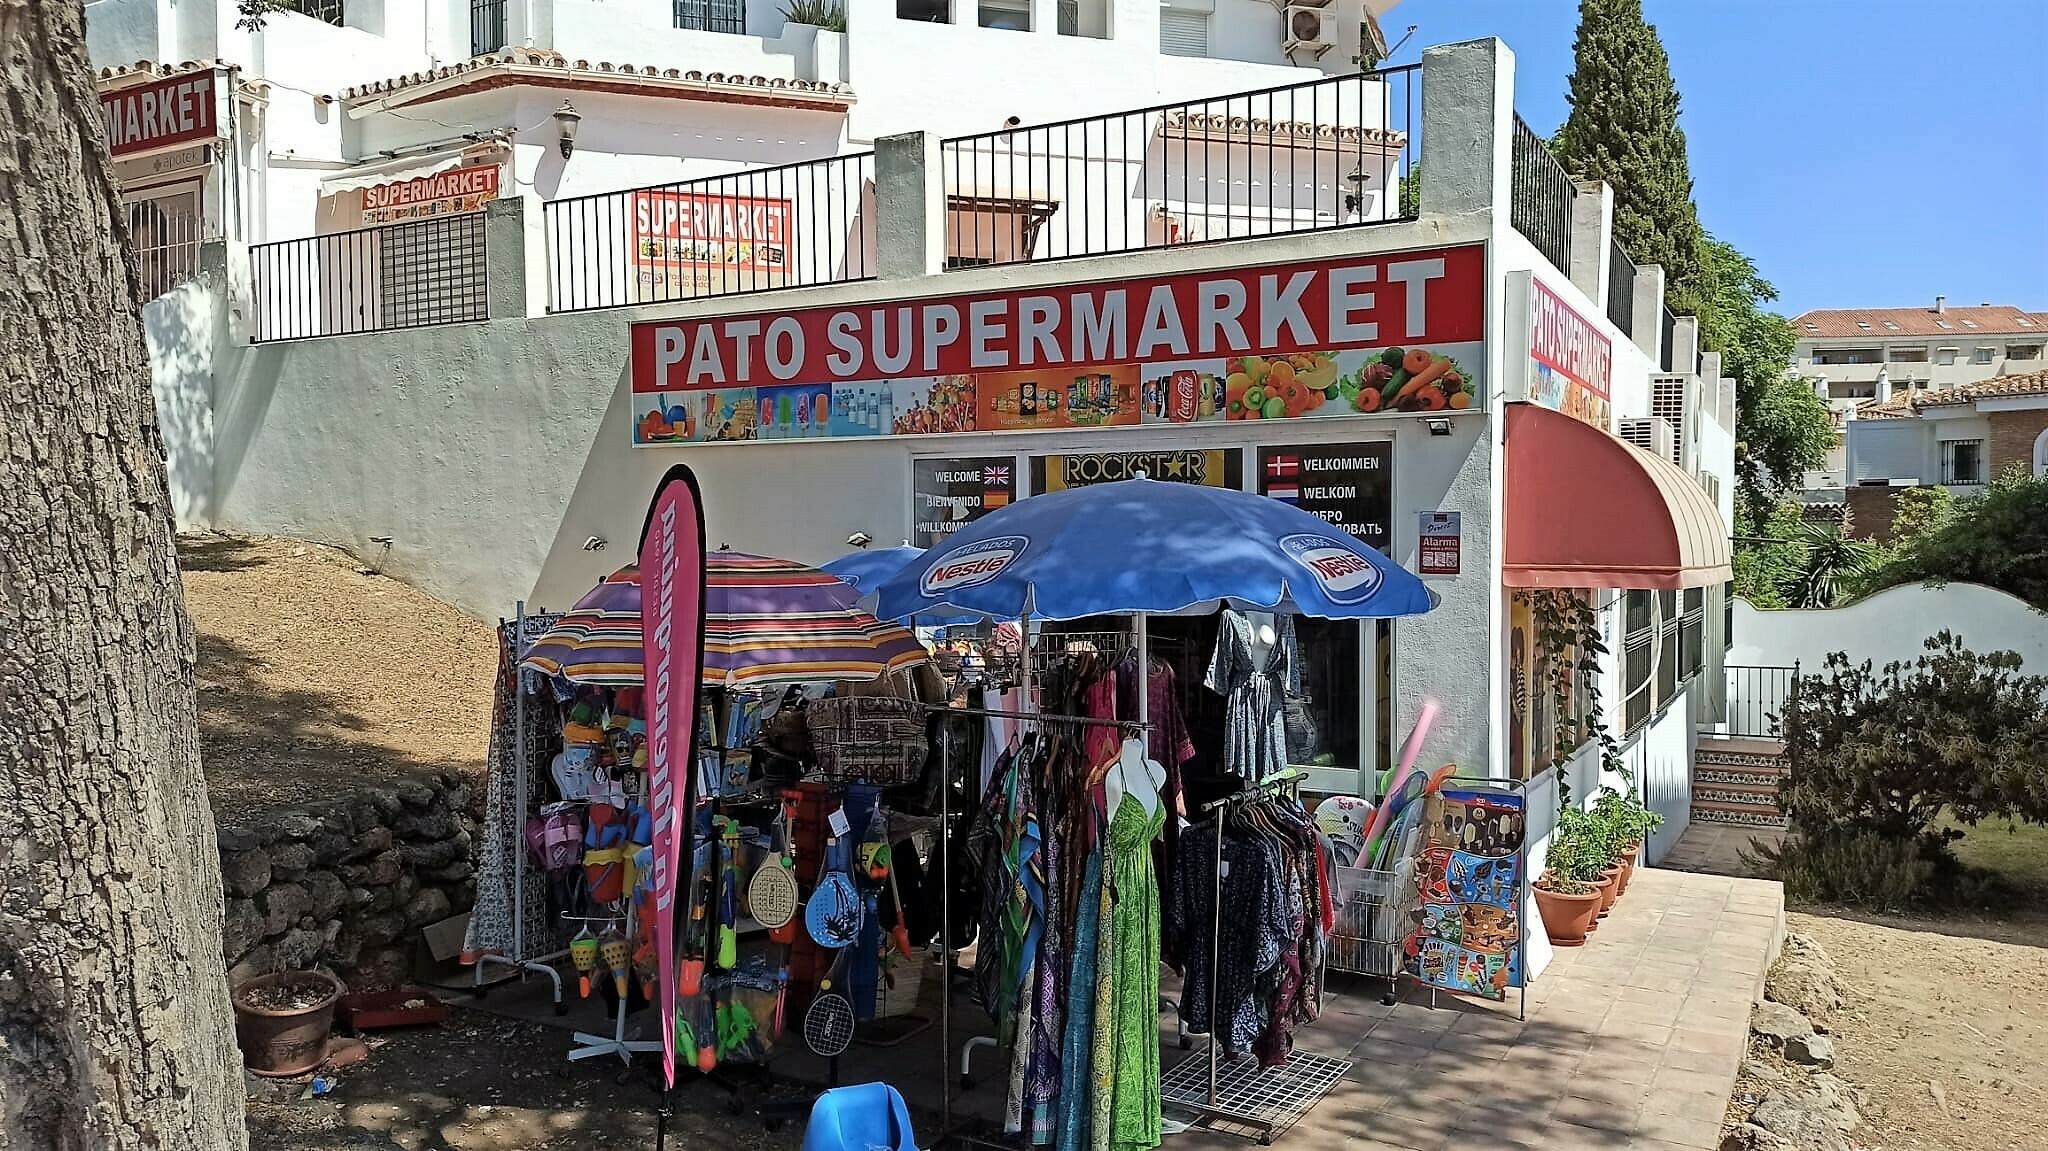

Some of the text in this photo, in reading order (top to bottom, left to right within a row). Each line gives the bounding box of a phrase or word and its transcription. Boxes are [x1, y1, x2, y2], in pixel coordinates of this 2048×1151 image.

[104, 78, 209, 147] MARKET
[163, 151, 198, 168] apotek
[366, 168, 496, 208] SUPERMARKET
[638, 197, 787, 242] SUPERMARKET
[655, 258, 1445, 386] PATO SUPERMARKET
[1532, 284, 1610, 396] PATO SUPERMARKET
[1303, 457, 1379, 471] VELKOMMEN
[935, 470, 981, 482] WELCOME
[1303, 486, 1356, 499] WELKOM
[926, 495, 981, 507] BIENVENIDO
[1306, 510, 1343, 522] ОБРО
[1423, 537, 1458, 546] Alarma
